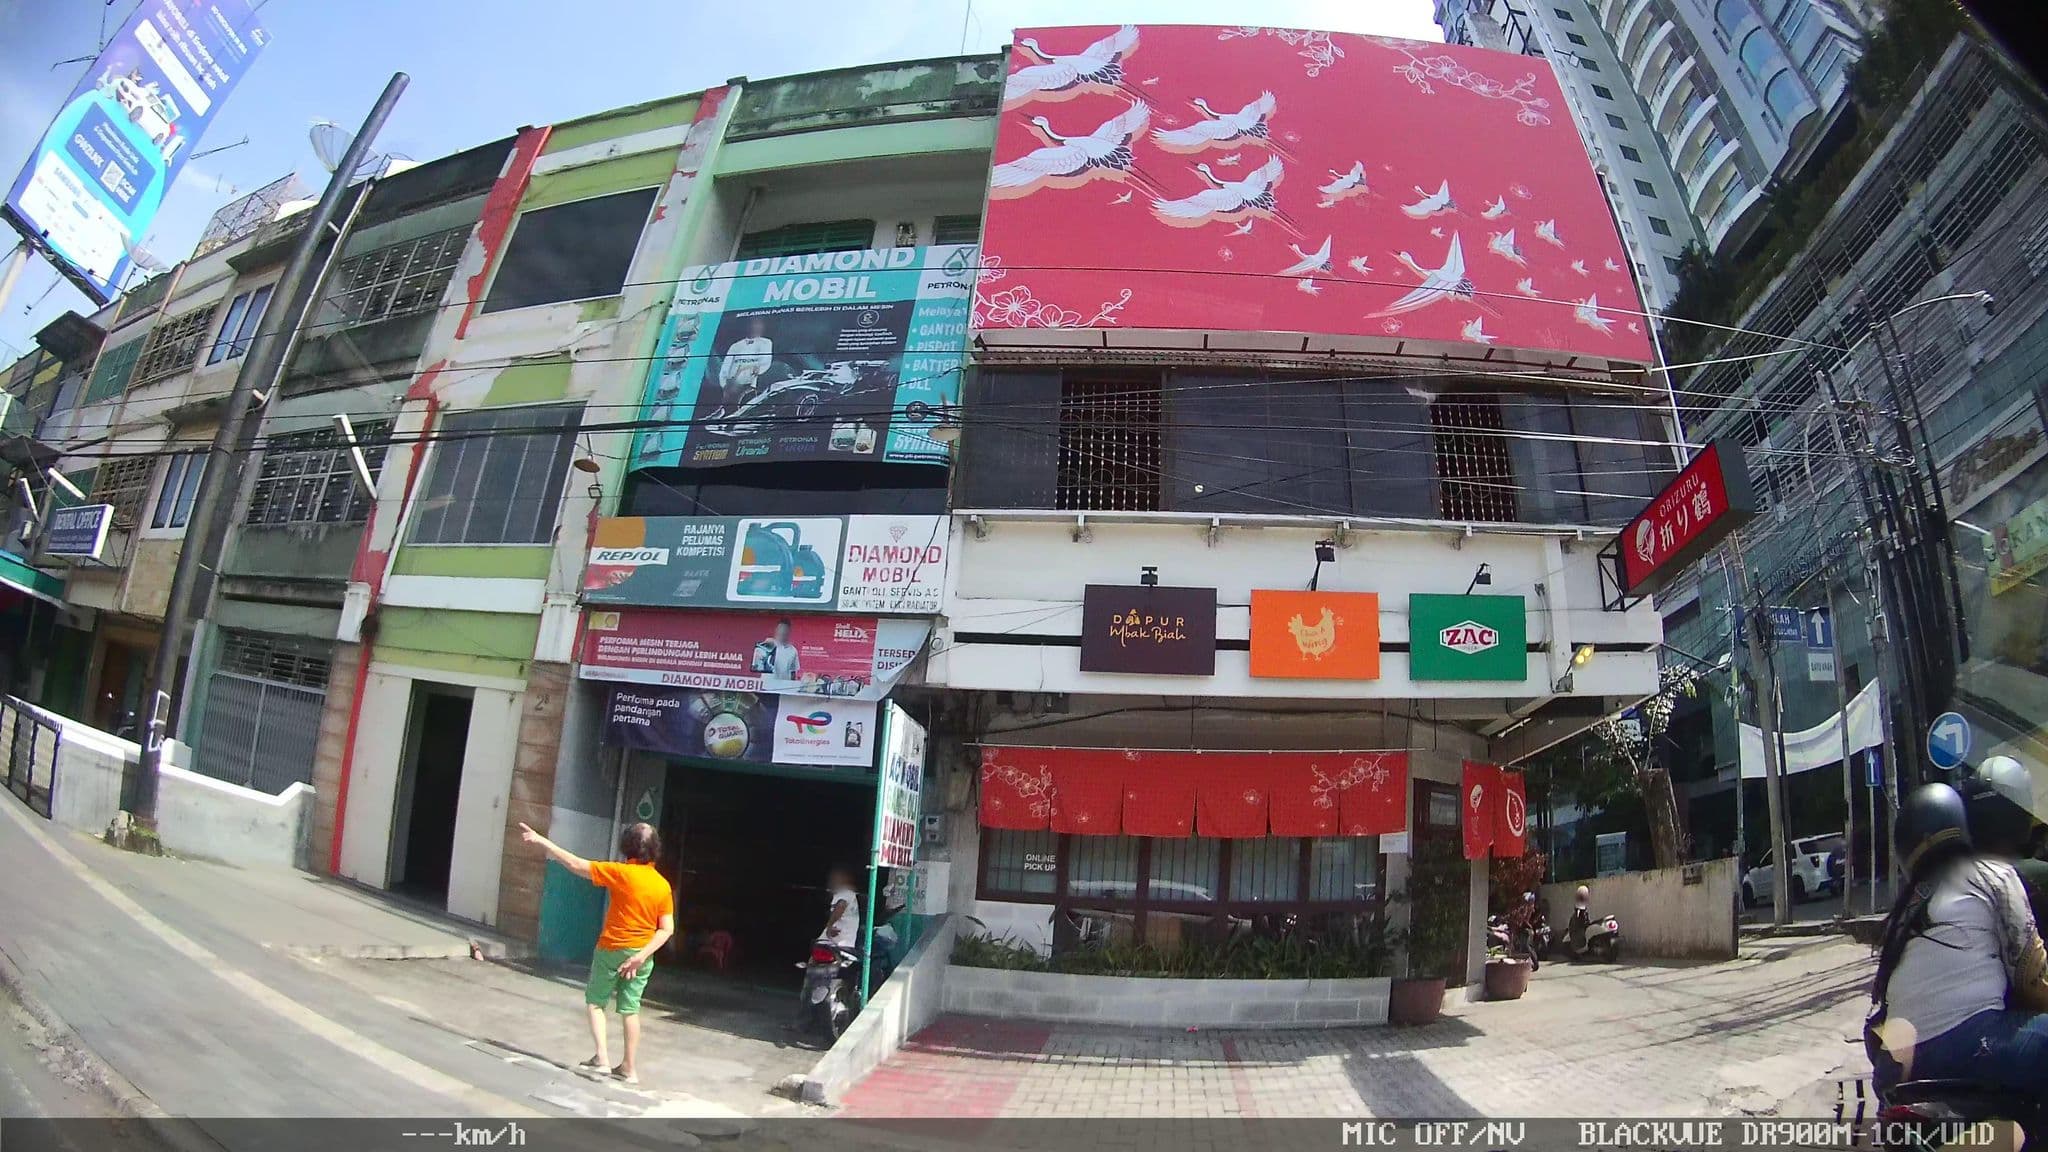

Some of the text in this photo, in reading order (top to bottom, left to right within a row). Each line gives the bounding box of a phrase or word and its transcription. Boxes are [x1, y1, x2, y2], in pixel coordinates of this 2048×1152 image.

[744, 247, 916, 275] DIAMOND
[763, 276, 877, 303] MOBIL
[1659, 472, 1699, 517] ORIZURU
[1659, 481, 1712, 551] 折り鶴
[684, 525, 725, 534] RAJANYA
[682, 536, 724, 545] PELUMAS
[597, 551, 661, 561] REPSOL
[676, 546, 725, 556] KOMPETISI
[848, 545, 942, 563] DIAMOND
[863, 567, 921, 582] MOBIL
[1113, 610, 1185, 626] DAPUR
[834, 628, 868, 639] HELIX
[1110, 625, 1150, 647] Mbak
[1446, 628, 1493, 645] ZAC
[664, 640, 699, 649] TERJAGA
[598, 645, 743, 661] DENGAN PERLINDUNGAN LEBIH LAMA
[662, 673, 766, 691] DIAMOND MOBIL
[614, 704, 661, 718] pandangan
[656, 699, 680, 708] pada
[613, 713, 651, 727] pertama
[1024, 862, 1056, 871] PICK UP
